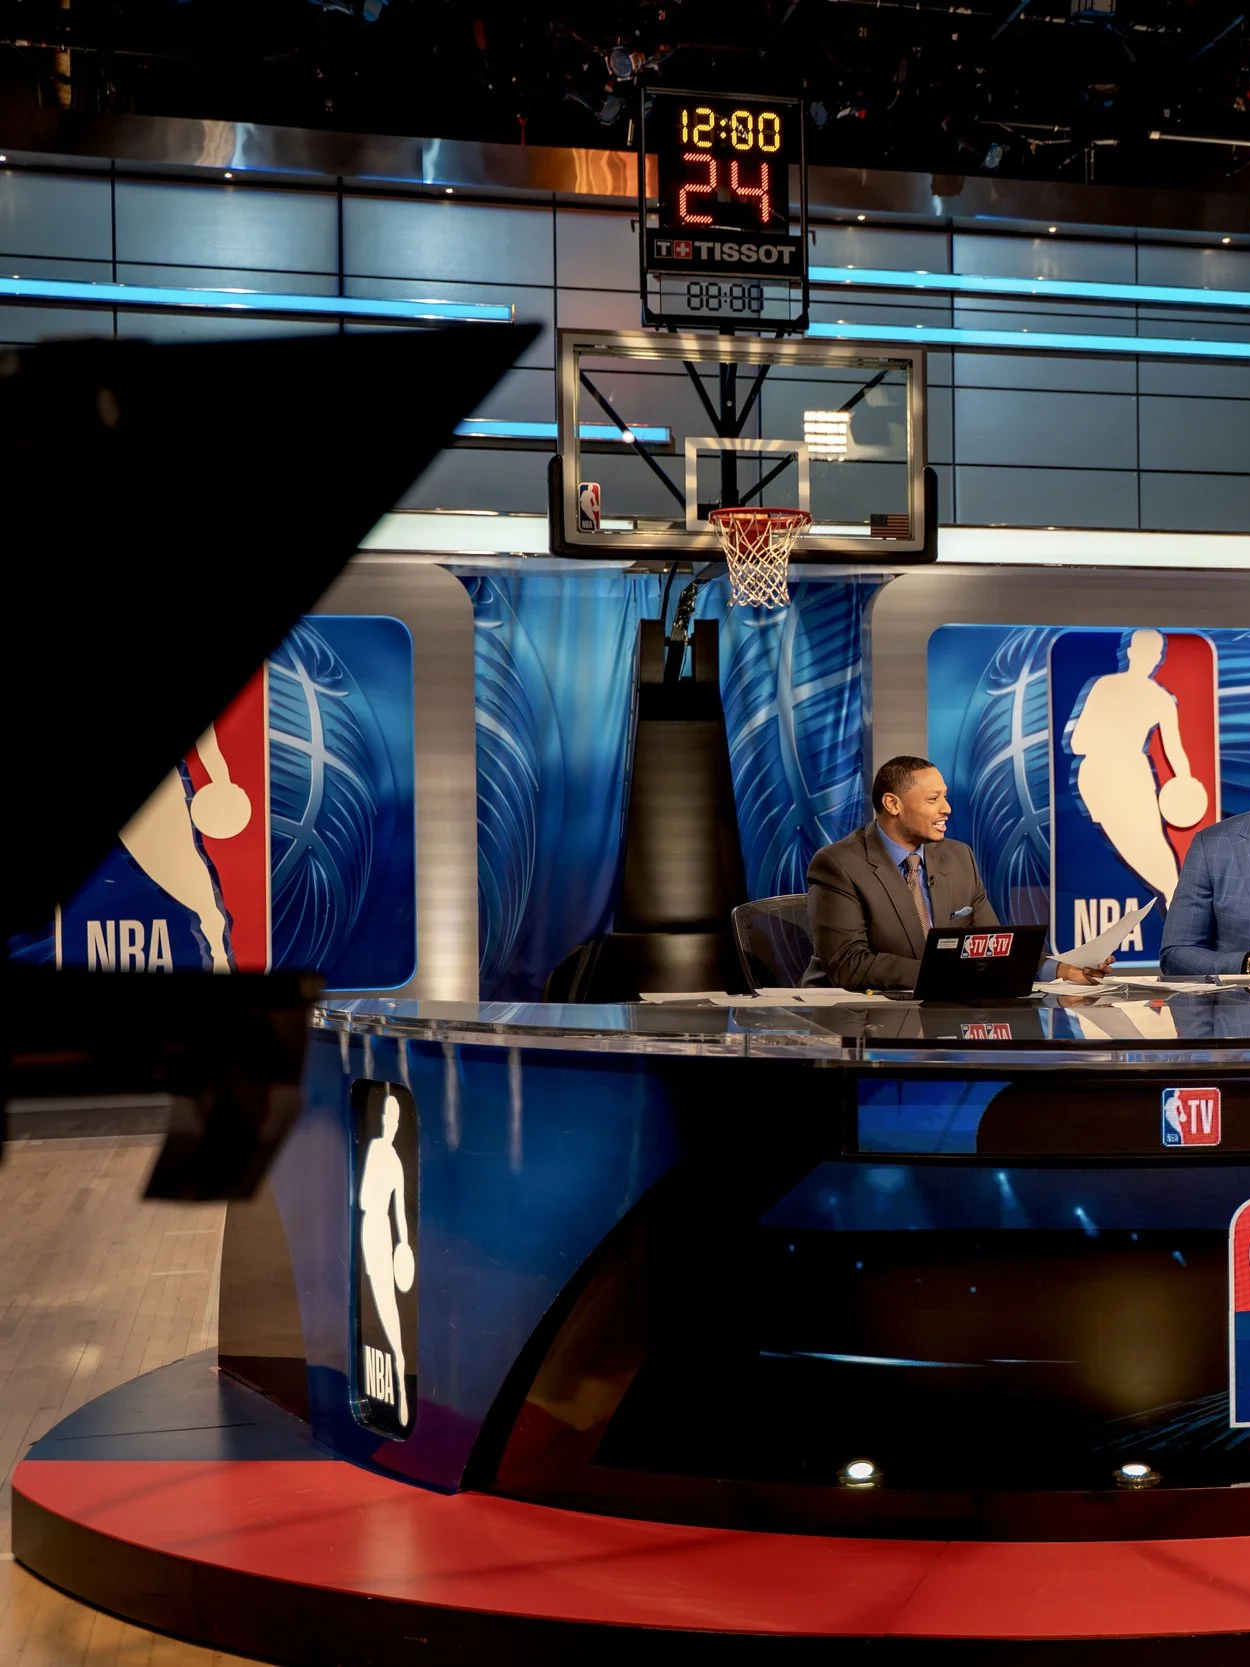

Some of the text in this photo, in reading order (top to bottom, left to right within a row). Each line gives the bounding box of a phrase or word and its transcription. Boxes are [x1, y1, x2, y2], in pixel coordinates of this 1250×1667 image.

[681, 107, 780, 152] 12:00
[679, 152, 769, 223] 24
[694, 241, 796, 265] TISSOT
[973, 939, 987, 954] TV
[996, 937, 1010, 952] TV
[1187, 1099, 1214, 1135] TV
[364, 1344, 395, 1406] NBA
